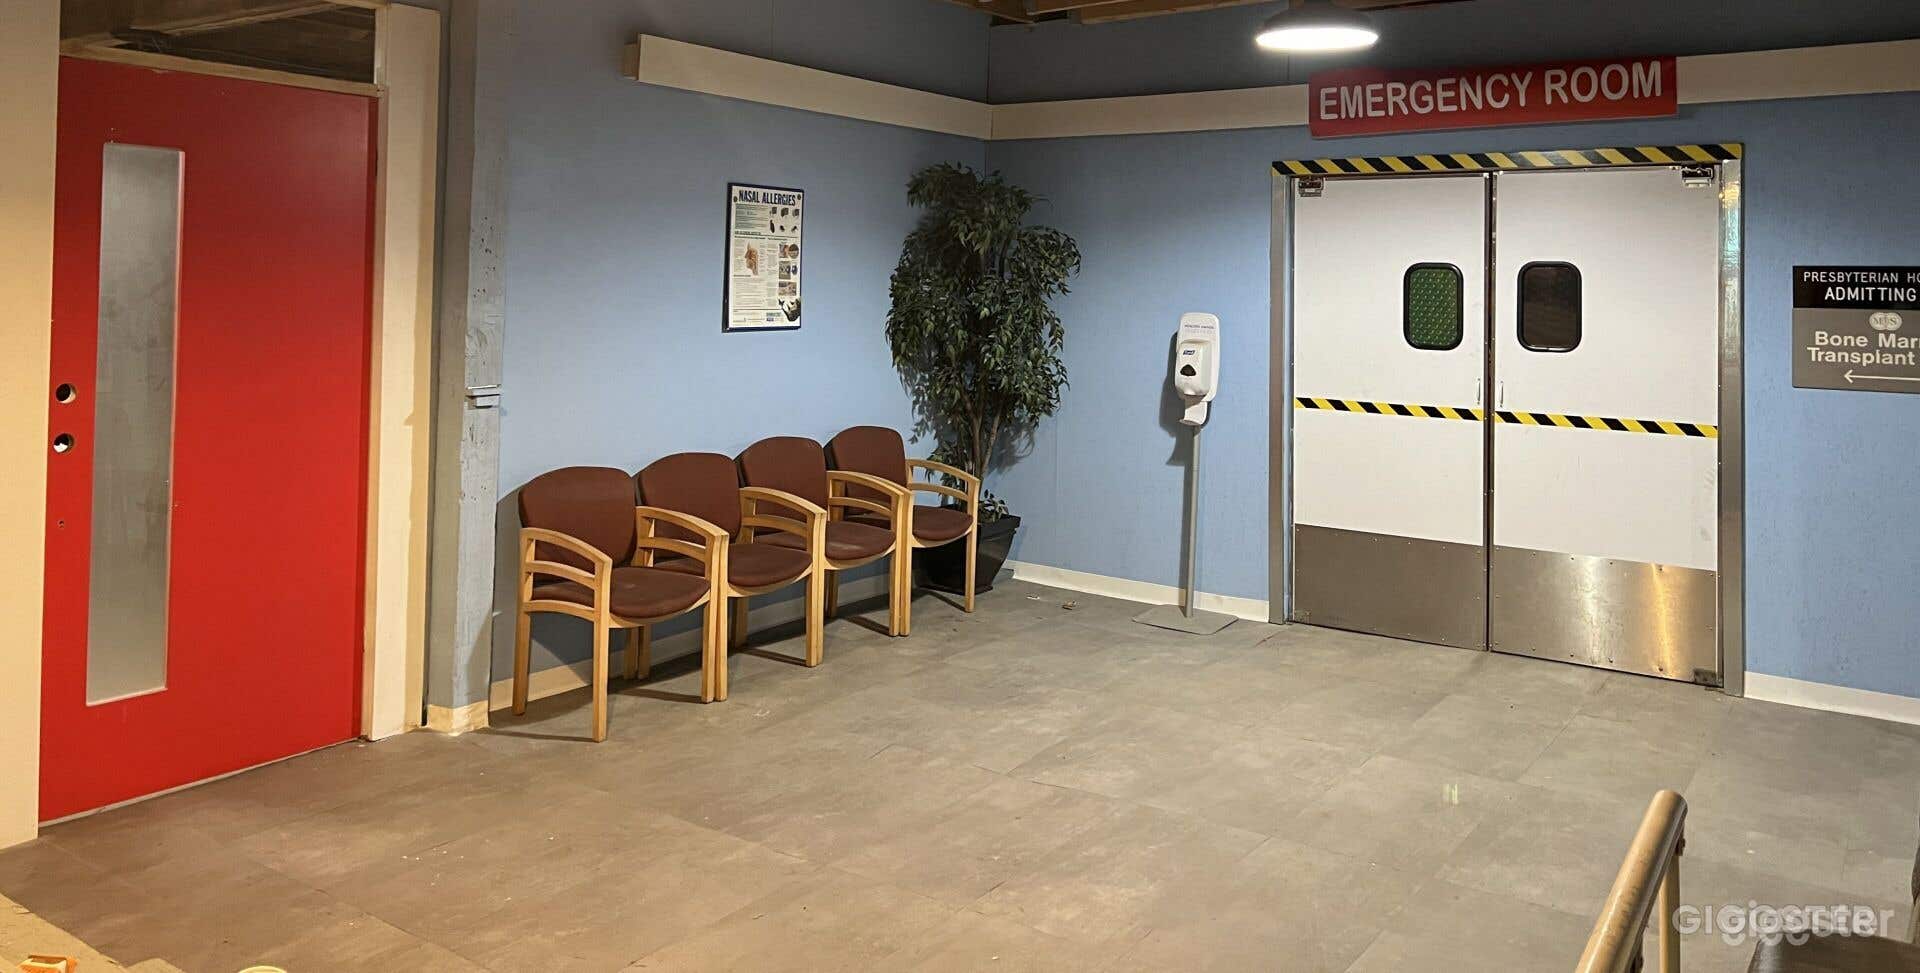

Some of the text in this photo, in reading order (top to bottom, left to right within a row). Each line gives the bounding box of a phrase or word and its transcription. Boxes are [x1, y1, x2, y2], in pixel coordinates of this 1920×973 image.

[1320, 60, 1662, 120] EMERGENCY ROOM
[739, 190, 796, 206] NASAL ALLERGIES
[1803, 271, 1899, 283] PRESBYTERIAN
[1824, 286, 1917, 302] ADMITTING
[1815, 331, 1920, 349] Bone Mar
[1807, 347, 1915, 367] Transplant
